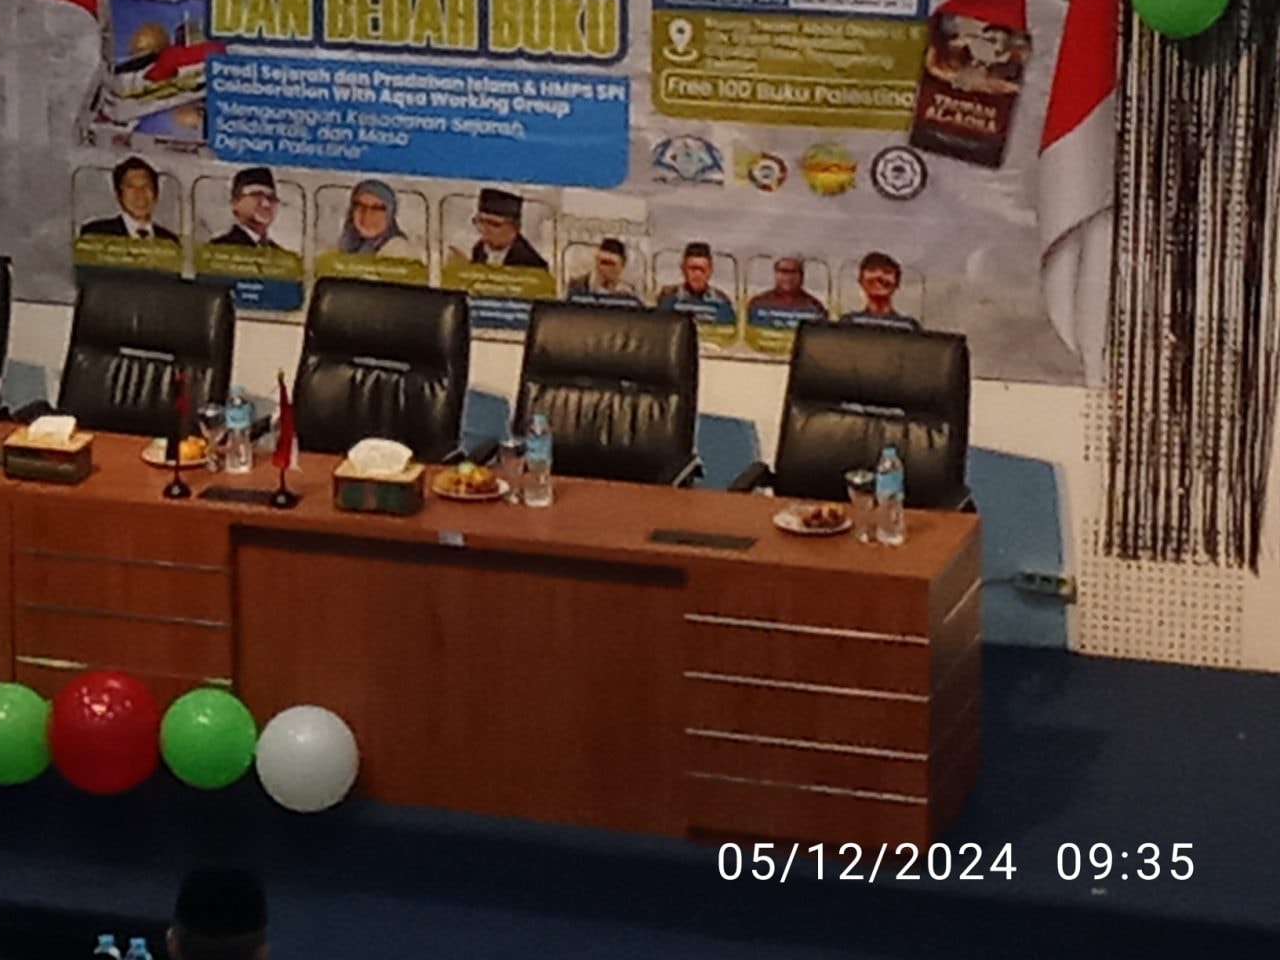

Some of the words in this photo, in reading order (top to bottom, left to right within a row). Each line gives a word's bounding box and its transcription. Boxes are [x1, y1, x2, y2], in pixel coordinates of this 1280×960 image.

[333, 69, 370, 85] dan
[523, 80, 537, 96] &
[668, 76, 713, 97] Free
[719, 79, 751, 99] 100
[756, 81, 809, 102] Buku
[431, 92, 509, 115] Working
